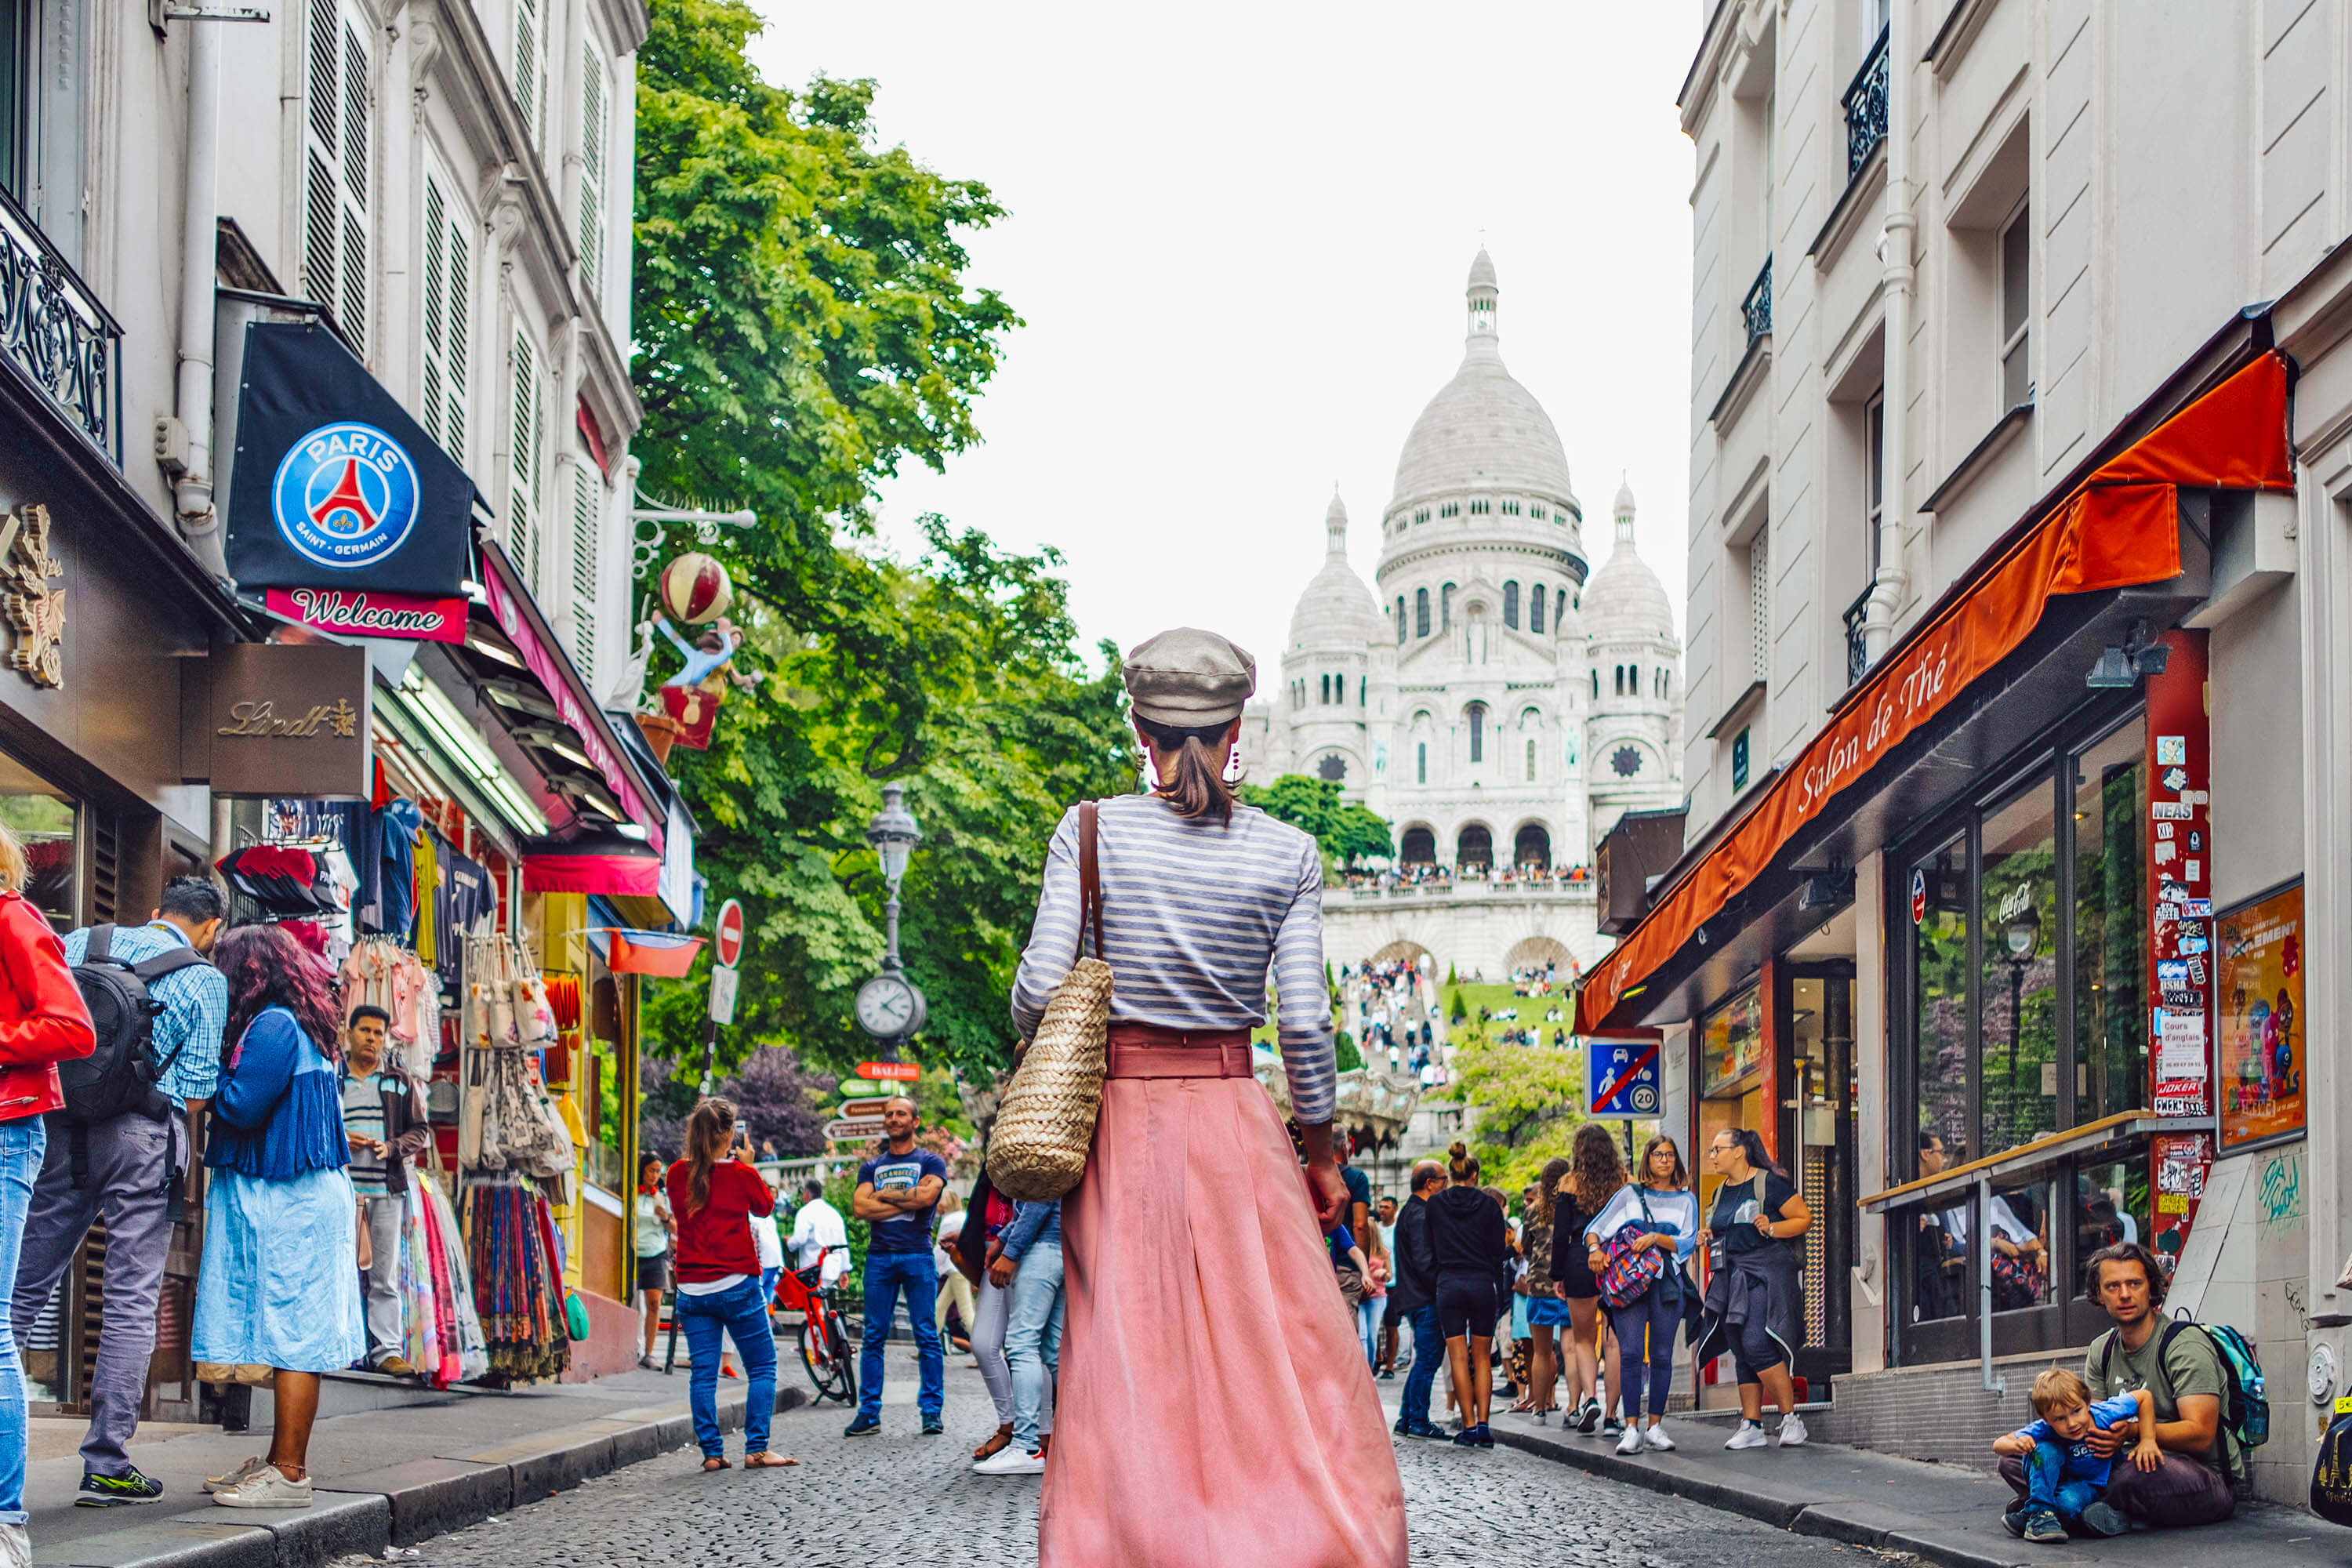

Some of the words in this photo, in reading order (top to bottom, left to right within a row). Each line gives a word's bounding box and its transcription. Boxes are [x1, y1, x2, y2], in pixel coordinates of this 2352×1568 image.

[306, 433, 400, 473] PARIS
[296, 521, 327, 550] SAINT
[334, 532, 388, 555] GERMAIN
[291, 588, 444, 630] Welcome
[217, 701, 331, 738] Lindt
[1798, 735, 1860, 813] Salon
[1866, 692, 1893, 752] de
[1900, 641, 1947, 720] Thé
[2165, 1022, 2188, 1030] Cours
[1637, 1093, 1653, 1104] 20
[2159, 1083, 2197, 1094] JOKER
